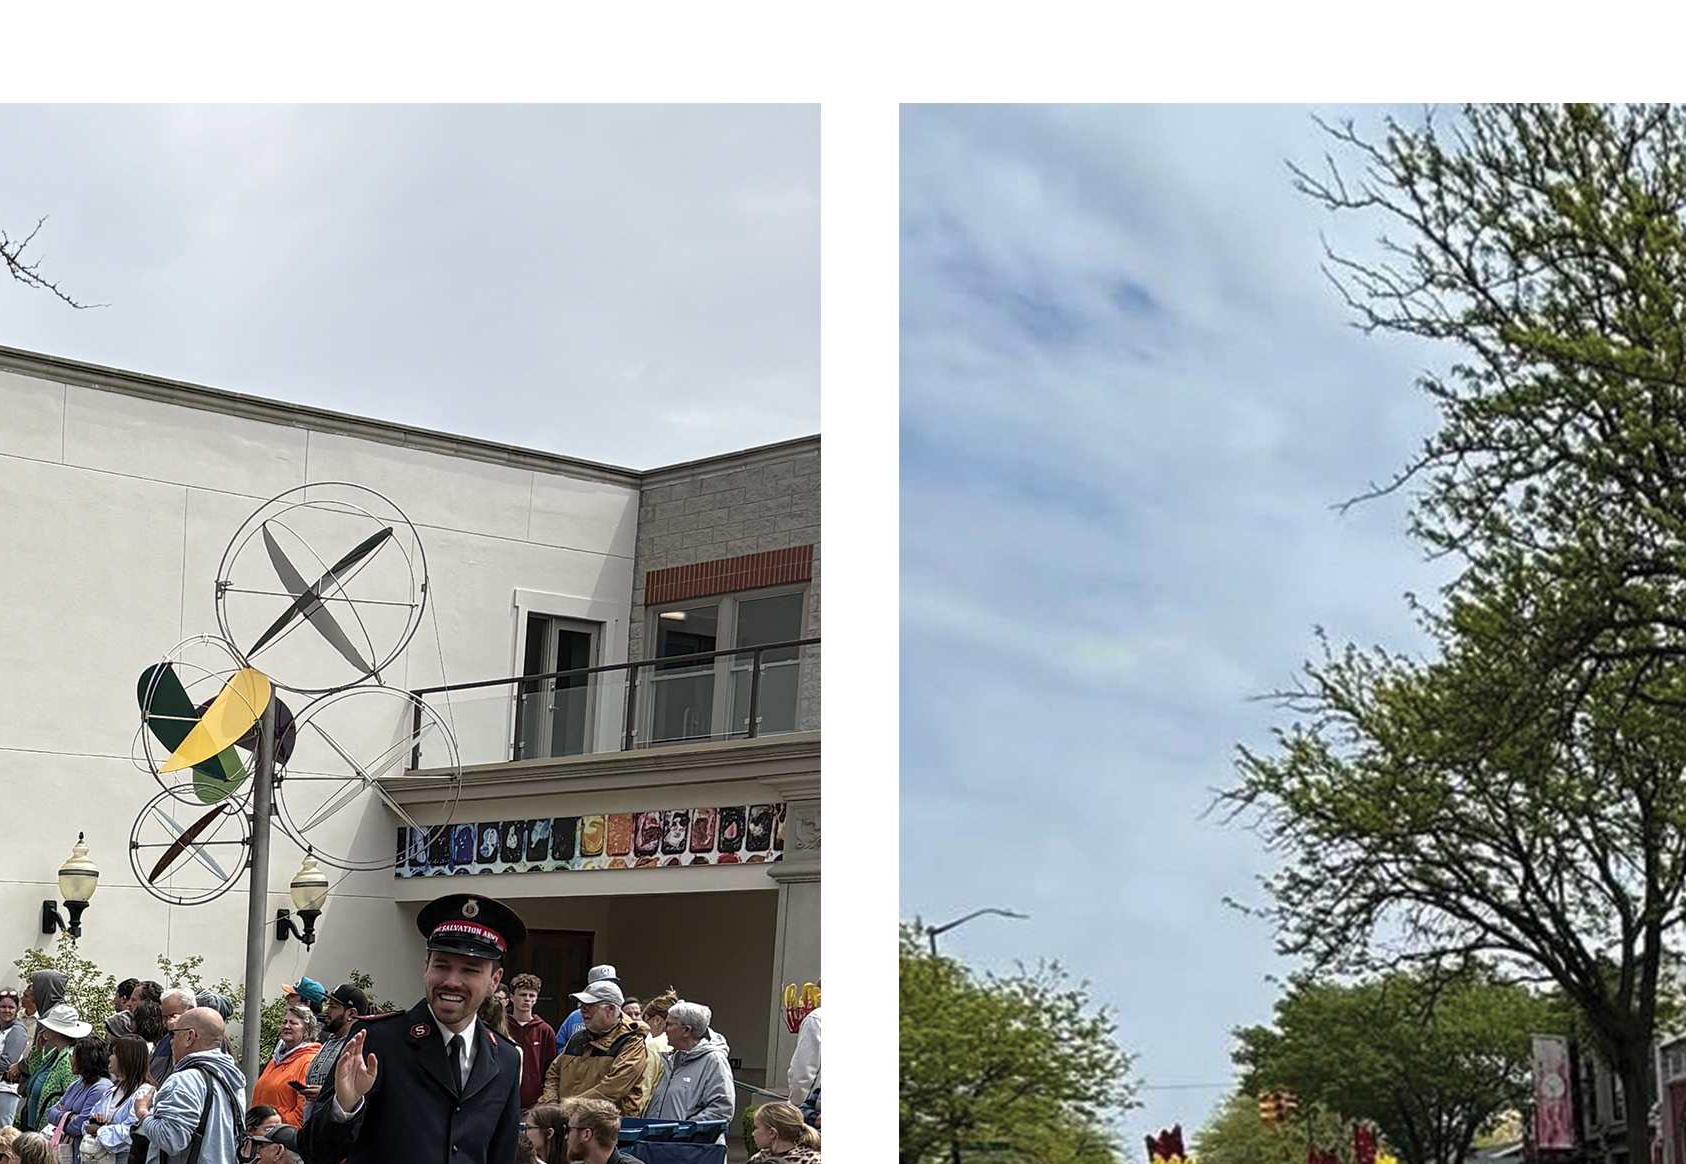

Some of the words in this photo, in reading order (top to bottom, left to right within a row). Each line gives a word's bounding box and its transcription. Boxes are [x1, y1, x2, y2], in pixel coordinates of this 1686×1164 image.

[442, 924, 482, 935] SALVATION
[482, 930, 499, 943] ARMY
[415, 1026, 425, 1036] S
